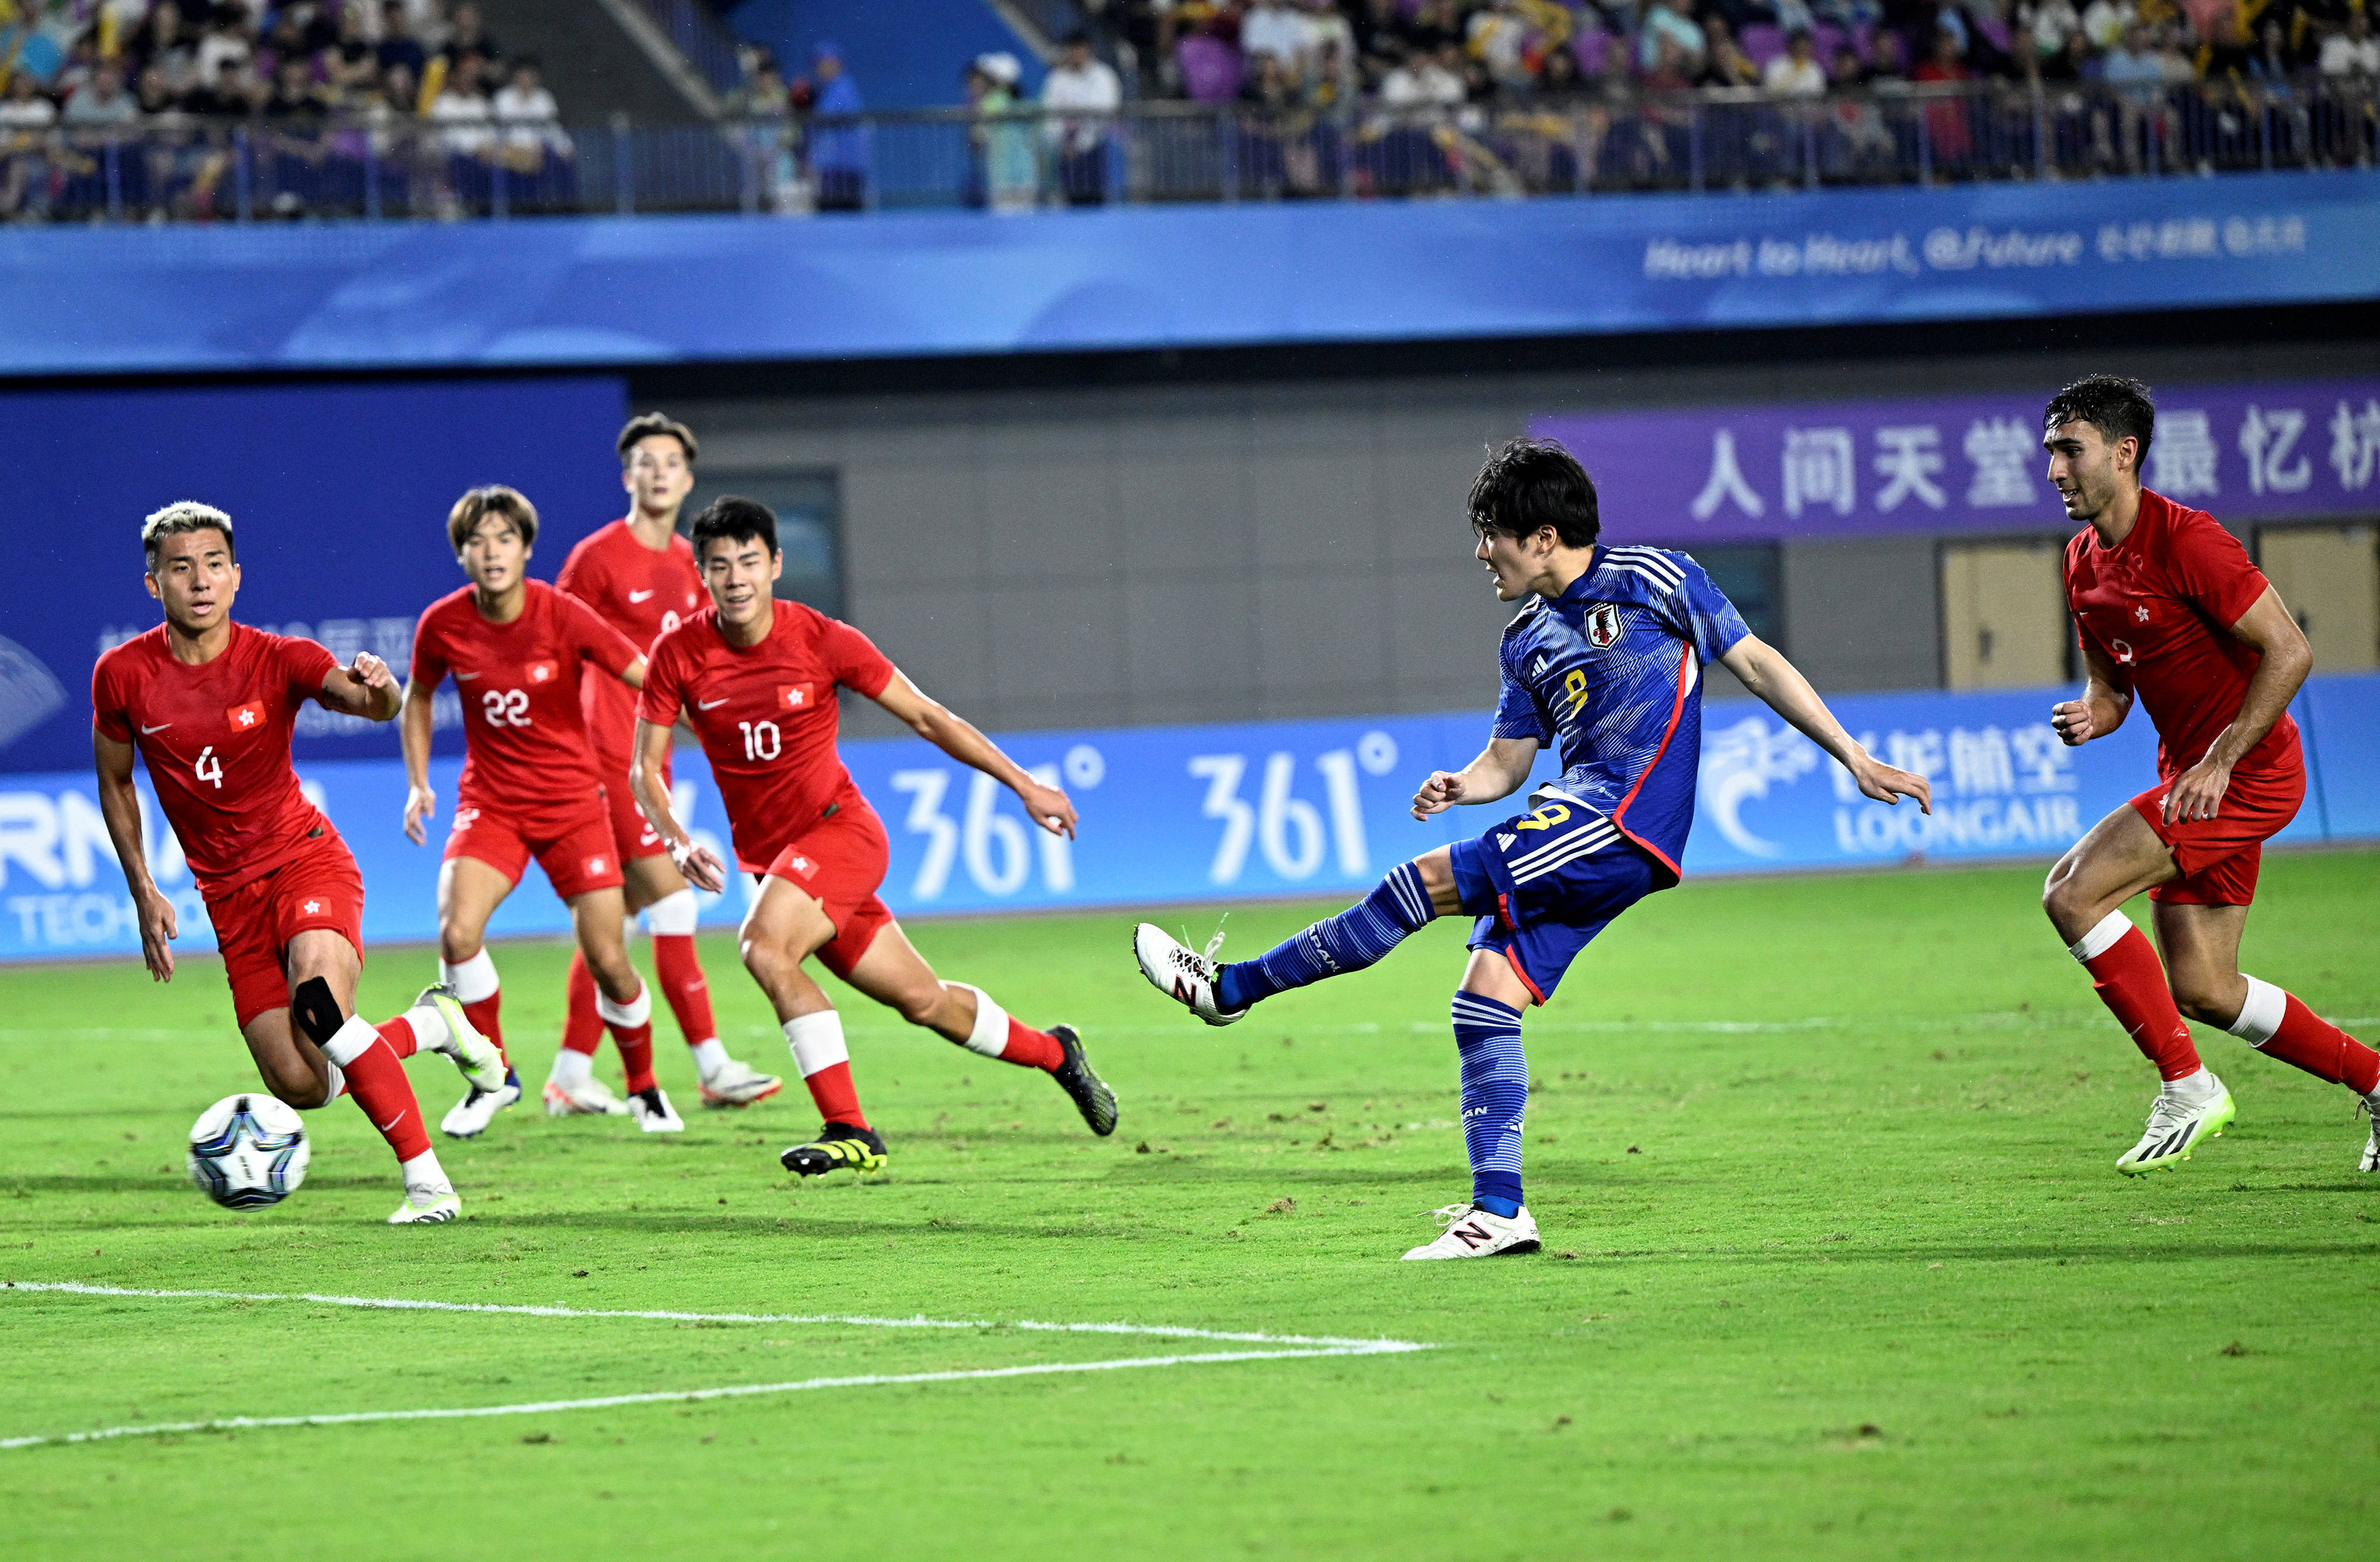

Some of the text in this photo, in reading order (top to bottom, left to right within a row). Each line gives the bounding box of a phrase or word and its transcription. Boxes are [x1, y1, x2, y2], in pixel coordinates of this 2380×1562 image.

[1691, 415, 2037, 521] 人间天堂
[482, 688, 532, 727] 22
[738, 720, 781, 761] 10
[195, 745, 224, 789] 4
[1833, 795, 2081, 853] LOONGAIR
